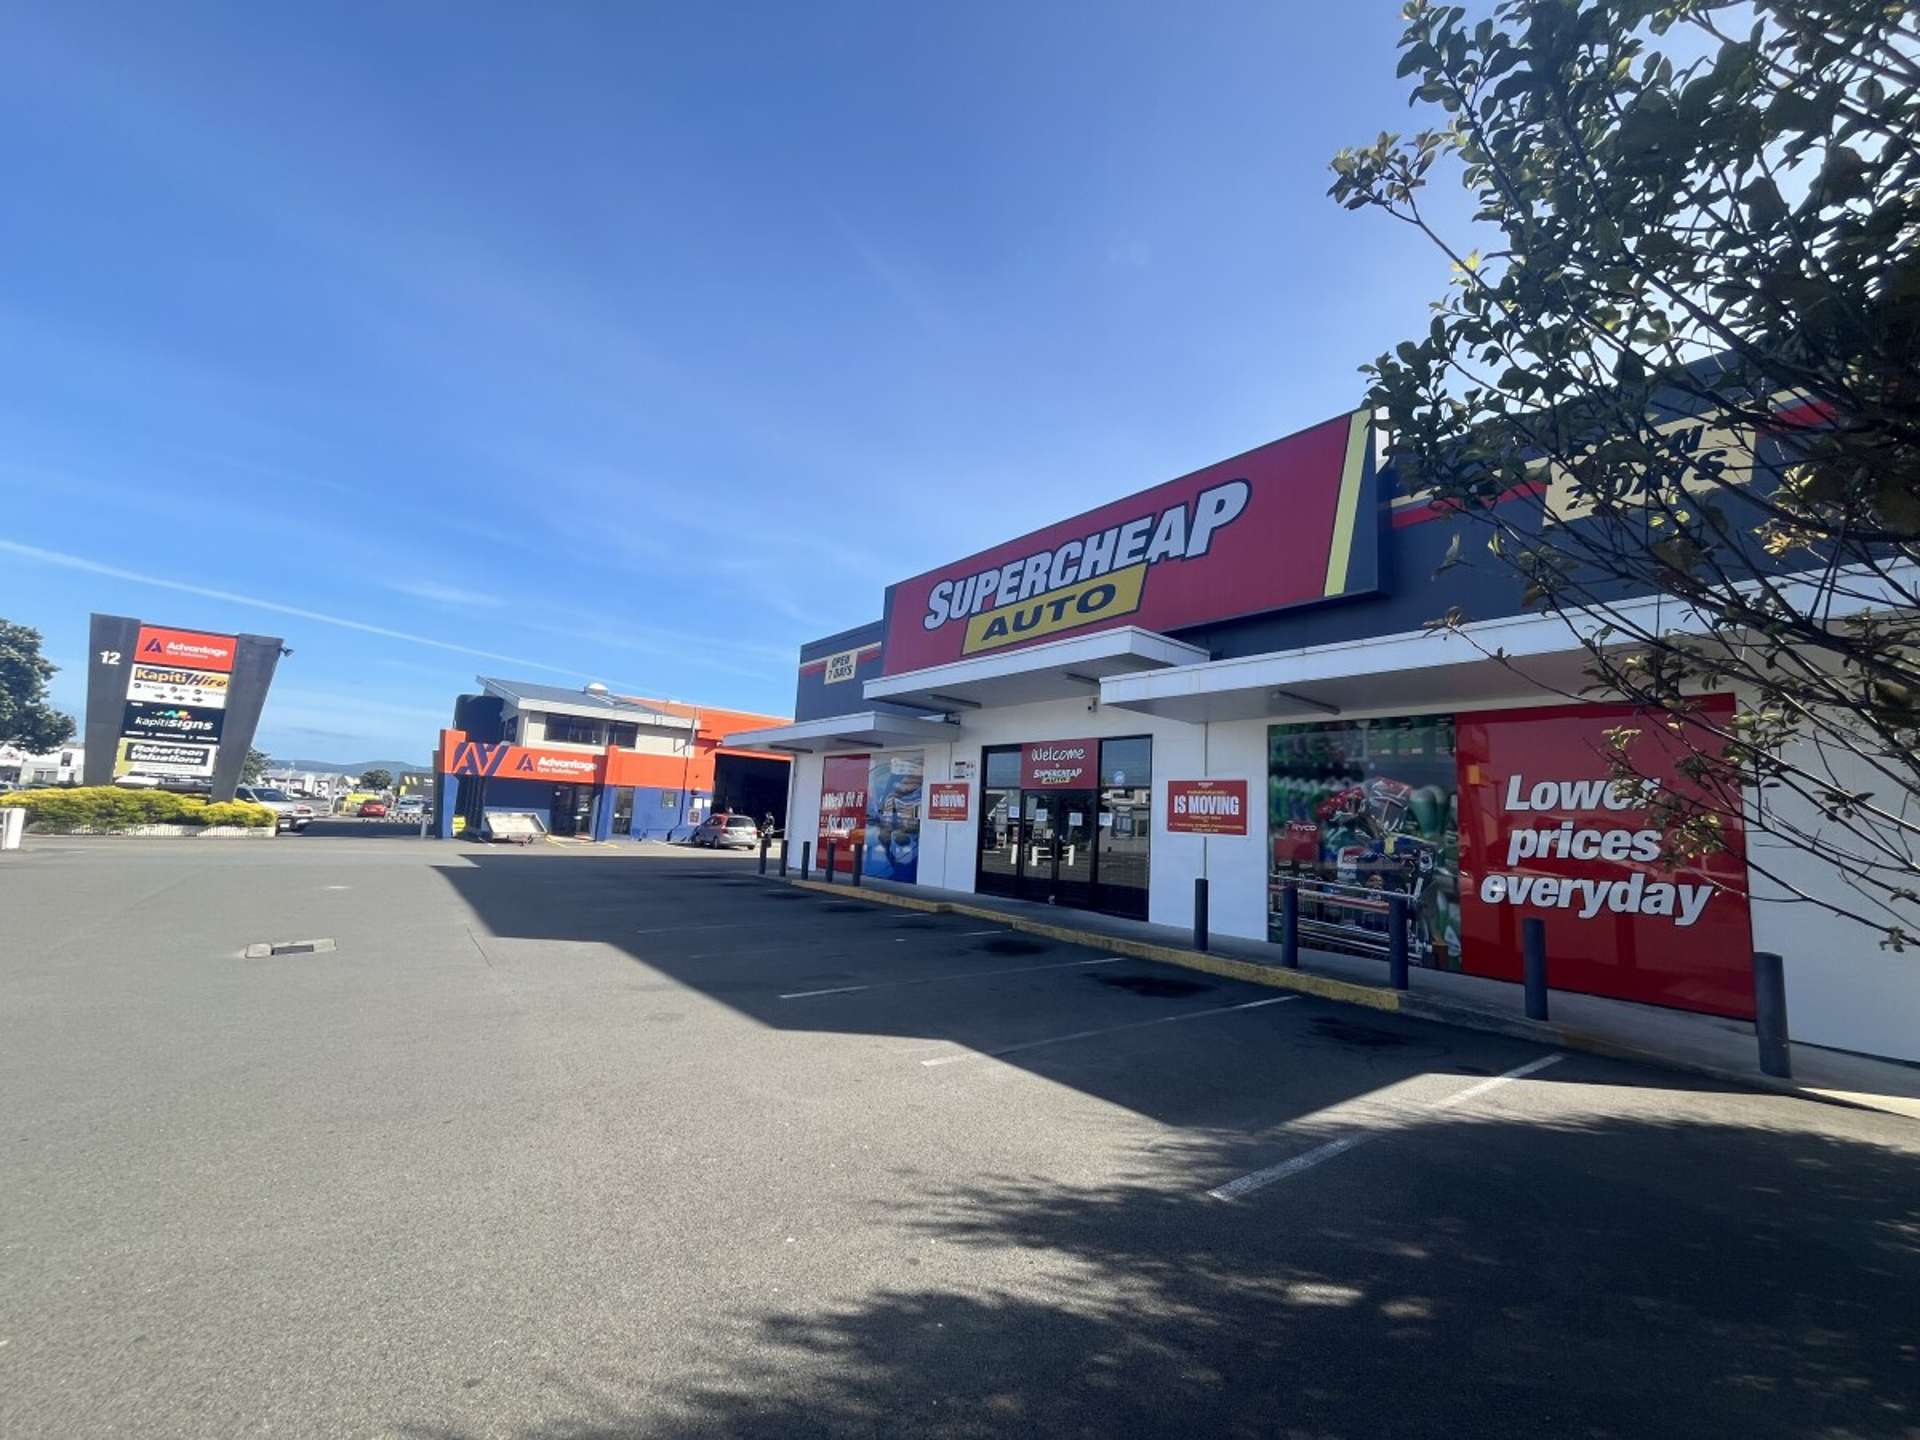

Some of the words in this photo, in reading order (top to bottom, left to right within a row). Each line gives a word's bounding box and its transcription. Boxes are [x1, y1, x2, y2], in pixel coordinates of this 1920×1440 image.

[923, 479, 1251, 630] SUPERCHEAP
[982, 584, 1116, 642] AUTO
[100, 650, 121, 665] 12
[166, 642, 228, 657] Advantage
[136, 668, 187, 684] Kapiti
[188, 675, 226, 687] Hire
[130, 752, 202, 764] Valuations
[132, 745, 204, 757] Robertson
[1031, 746, 1086, 762] Welcome
[537, 757, 597, 771] Advantage
[1174, 795, 1186, 814] IS
[1188, 795, 1240, 816] MOVING
[1506, 821, 1662, 866] prices
[1480, 873, 1713, 926] everyday
